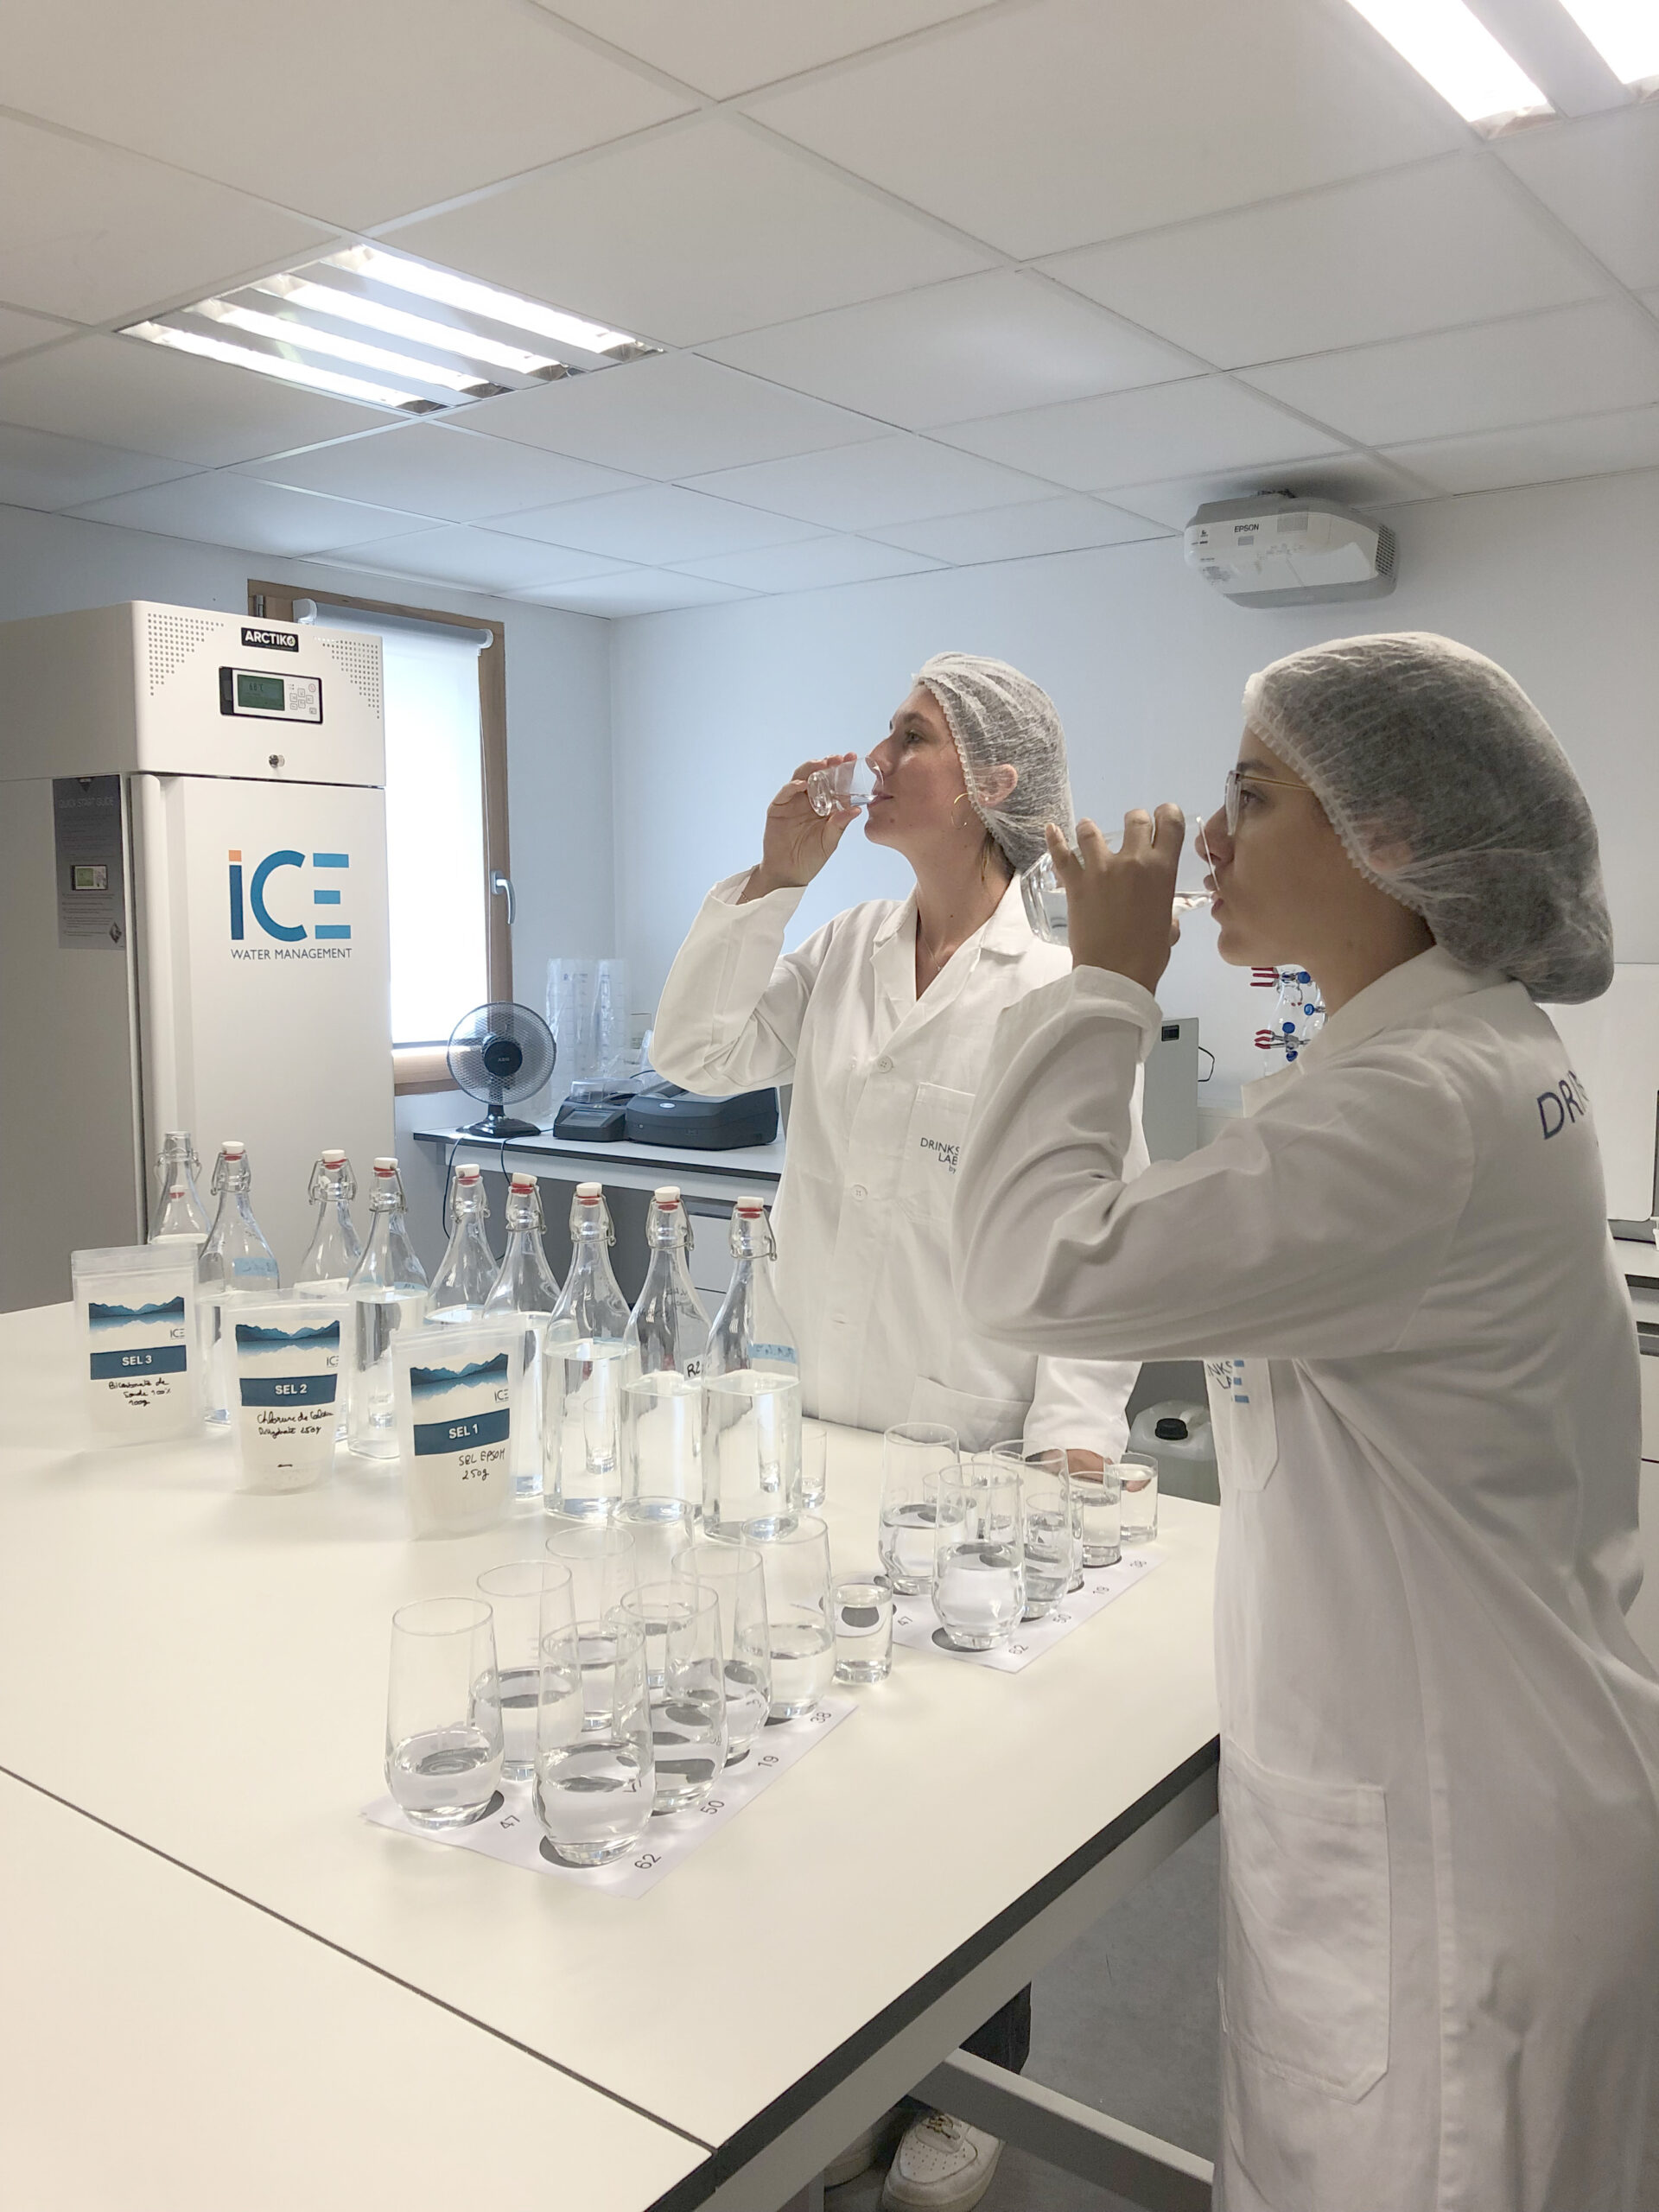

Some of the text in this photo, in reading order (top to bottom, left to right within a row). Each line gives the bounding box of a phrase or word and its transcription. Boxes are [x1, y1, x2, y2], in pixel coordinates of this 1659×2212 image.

[1234, 524, 1260, 533] EPSON
[245, 630, 296, 647] ARCTIKO
[231, 948, 353, 960] WATER MANAGEMENT
[122, 1355, 152, 1366] SEL 3
[275, 1383, 308, 1395] SEL 2
[494, 1389, 509, 1402] ICE
[448, 1423, 479, 1440] SEL 1
[810, 1712, 832, 1725] 38
[757, 1755, 779, 1768] 19
[700, 1799, 725, 1815] 50
[499, 1815, 521, 1830] 47
[634, 1853, 662, 1870] 62
